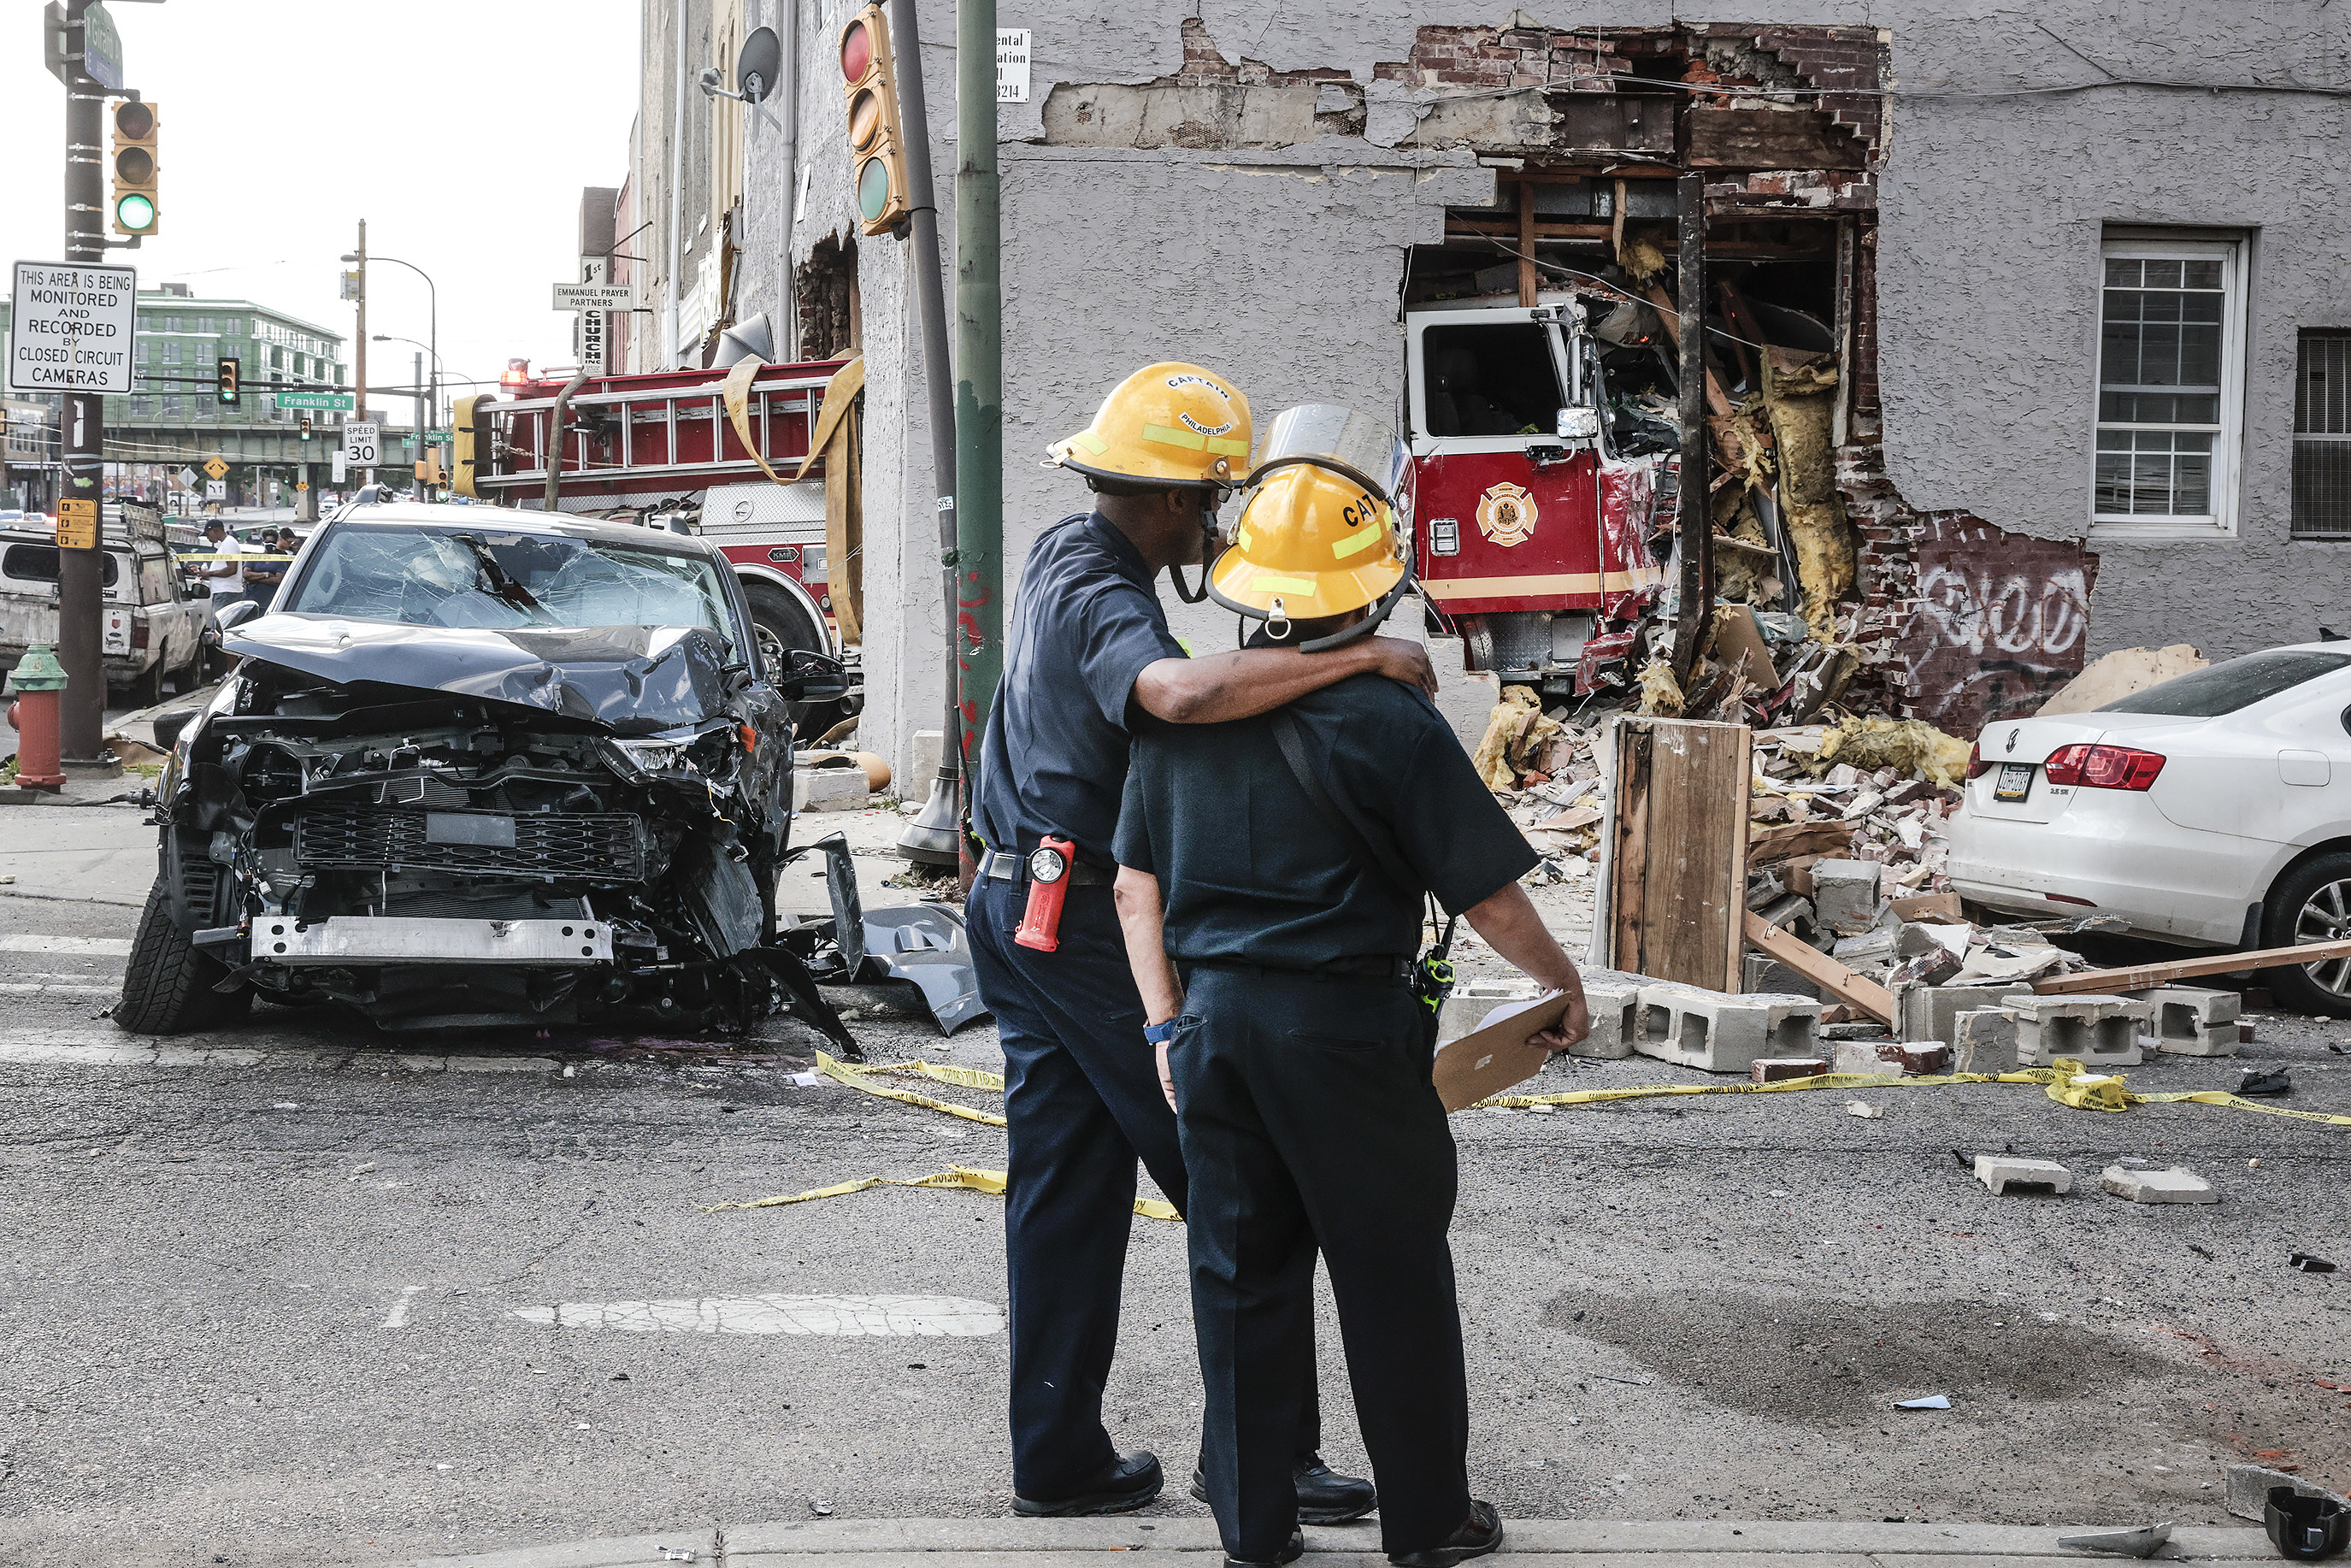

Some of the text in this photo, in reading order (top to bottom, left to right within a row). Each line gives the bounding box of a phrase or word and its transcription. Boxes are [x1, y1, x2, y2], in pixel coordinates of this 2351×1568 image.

[21, 270, 131, 291] THIS AREA IS BEING
[584, 263, 602, 284] 1st
[30, 289, 118, 307] MONITORED
[557, 288, 629, 298] EMMANUEL PRAYER
[570, 298, 613, 307] PARTNERS
[57, 309, 90, 319] AND
[28, 319, 116, 337] RECORDED
[585, 310, 601, 359] CHURCH
[62, 338, 80, 346] BY
[19, 346, 124, 366] CLOSED CIRCUIT
[32, 367, 108, 386] CAMERAS
[1168, 376, 1229, 399] CAPTAIN
[284, 397, 345, 408] Franklin St
[346, 427, 375, 435] SPEED
[1181, 414, 1231, 435] PHILADELPHIA
[349, 445, 374, 461] 30
